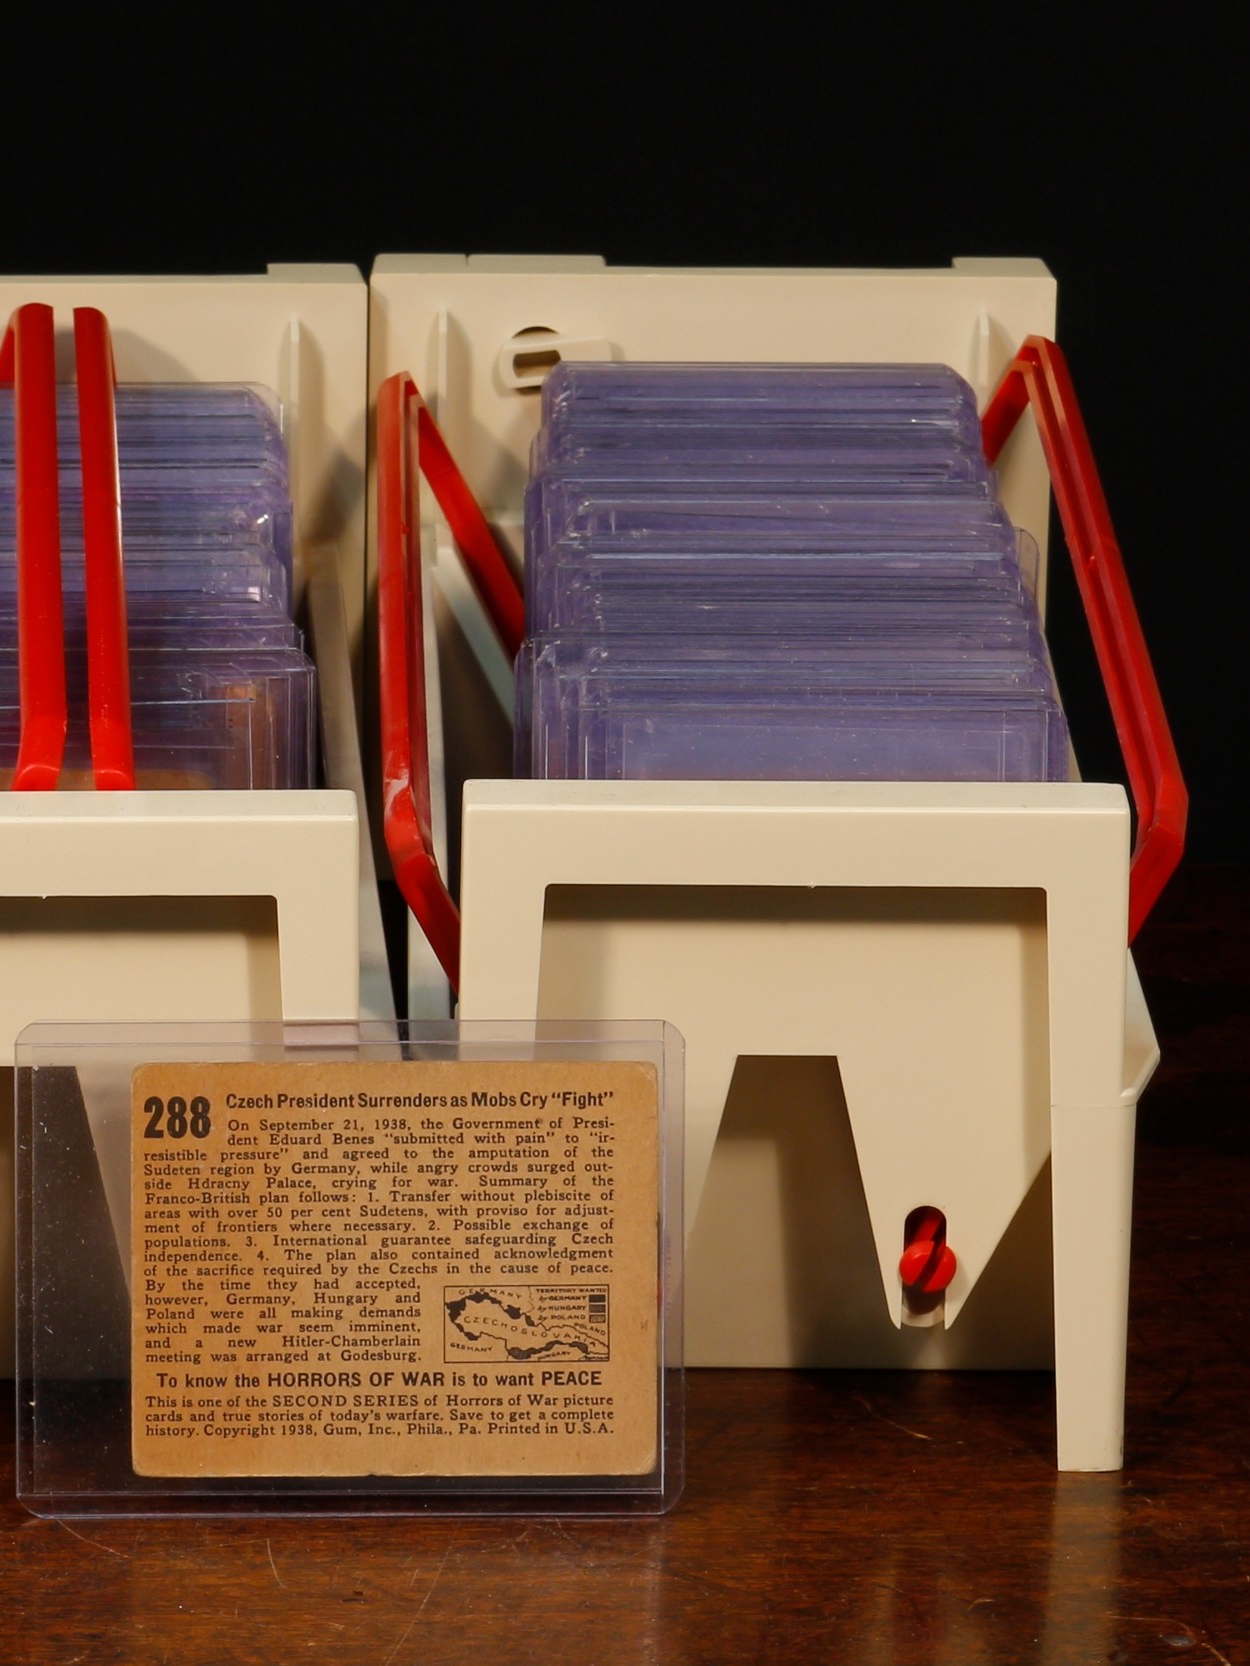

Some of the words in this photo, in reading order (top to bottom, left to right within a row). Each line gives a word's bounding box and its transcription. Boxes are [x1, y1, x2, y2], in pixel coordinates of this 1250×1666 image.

[226, 1093, 273, 1109] Czech
[277, 1093, 355, 1108] President
[358, 1093, 447, 1108] Surrenders
[450, 1096, 468, 1107] as
[471, 1092, 517, 1107] Mobs
[520, 1091, 548, 1109] Cry
[144, 1096, 212, 1138] 288
[228, 1119, 249, 1131] On
[260, 1119, 334, 1132] September
[343, 1119, 364, 1132] 21,
[375, 1118, 411, 1131] 1938,
[420, 1118, 444, 1129] the
[452, 1117, 543, 1129] Government
[549, 1117, 563, 1129] of
[572, 1116, 614, 1129] Presi-
[227, 1134, 258, 1146] dent
[269, 1132, 322, 1145] Eduard
[332, 1133, 374, 1145] Benes
[474, 1132, 506, 1144] with
[565, 1134, 579, 1143] to
[144, 1164, 201, 1176] Sudeten
[210, 1162, 254, 1177] region
[264, 1163, 281, 1176] by
[291, 1161, 360, 1176] Germany,
[370, 1162, 408, 1173] while
[417, 1163, 459, 1175] angry
[468, 1160, 518, 1173] crowds
[527, 1160, 575, 1175] surged
[584, 1162, 613, 1175] out-
[145, 1191, 250, 1204] Franco-British
[259, 1192, 289, 1204] plan
[299, 1191, 356, 1203] follows:
[368, 1192, 379, 1202] 1.
[389, 1190, 451, 1202] Transfer
[460, 1190, 515, 1202] without
[524, 1189, 590, 1202] plebiscite
[600, 1189, 614, 1201] of
[144, 1224, 180, 1233] ment
[192, 1221, 205, 1233] of
[217, 1220, 277, 1232] frontiers
[289, 1219, 331, 1232] where
[344, 1223, 415, 1233] necessary.
[428, 1220, 440, 1231] 2.
[453, 1218, 511, 1230] Possible
[523, 1219, 588, 1232] exchange
[600, 1218, 614, 1230] of
[145, 1279, 165, 1293] By
[182, 1278, 204, 1291] the
[220, 1278, 251, 1290] time
[267, 1277, 298, 1292] they
[314, 1278, 339, 1289] had
[355, 1277, 420, 1292] accepted,
[146, 1308, 195, 1319] Poland
[210, 1311, 244, 1319] were
[259, 1307, 277, 1319] all
[291, 1306, 343, 1320] making
[359, 1305, 421, 1321] demands
[145, 1337, 171, 1348] and
[195, 1340, 203, 1348] a
[228, 1339, 257, 1348] new
[282, 1335, 421, 1347] Hitler-Chamberlain
[156, 1373, 177, 1388] To
[185, 1373, 227, 1388] know
[235, 1373, 260, 1388] the
[268, 1372, 361, 1388] HORRORS
[369, 1372, 394, 1387] OF
[401, 1371, 445, 1386] WAR
[452, 1372, 466, 1387] is
[472, 1373, 488, 1387] to
[495, 1372, 534, 1386] want
[542, 1371, 602, 1386] PEACE
[146, 1410, 182, 1422] cards
[190, 1410, 215, 1422] and
[222, 1412, 251, 1422] true
[258, 1410, 304, 1421] stories
[309, 1409, 323, 1421] of
[386, 1409, 443, 1421] warfare.
[450, 1409, 483, 1421] Save
[490, 1411, 504, 1420] to
[509, 1411, 531, 1422] get
[538, 1412, 546, 1420] a
[551, 1407, 614, 1422] complete
[146, 1424, 199, 1438] history.
[204, 1424, 275, 1438] Copyright
[282, 1424, 317, 1437] 1938,
[323, 1422, 362, 1436] Gum,
[368, 1423, 401, 1436] Inc.,
[407, 1423, 452, 1436] Phila.,
[458, 1423, 481, 1434] Pa.
[488, 1421, 540, 1434] Printed
[545, 1422, 558, 1434] in
[564, 1421, 613, 1434] U.S.A.
